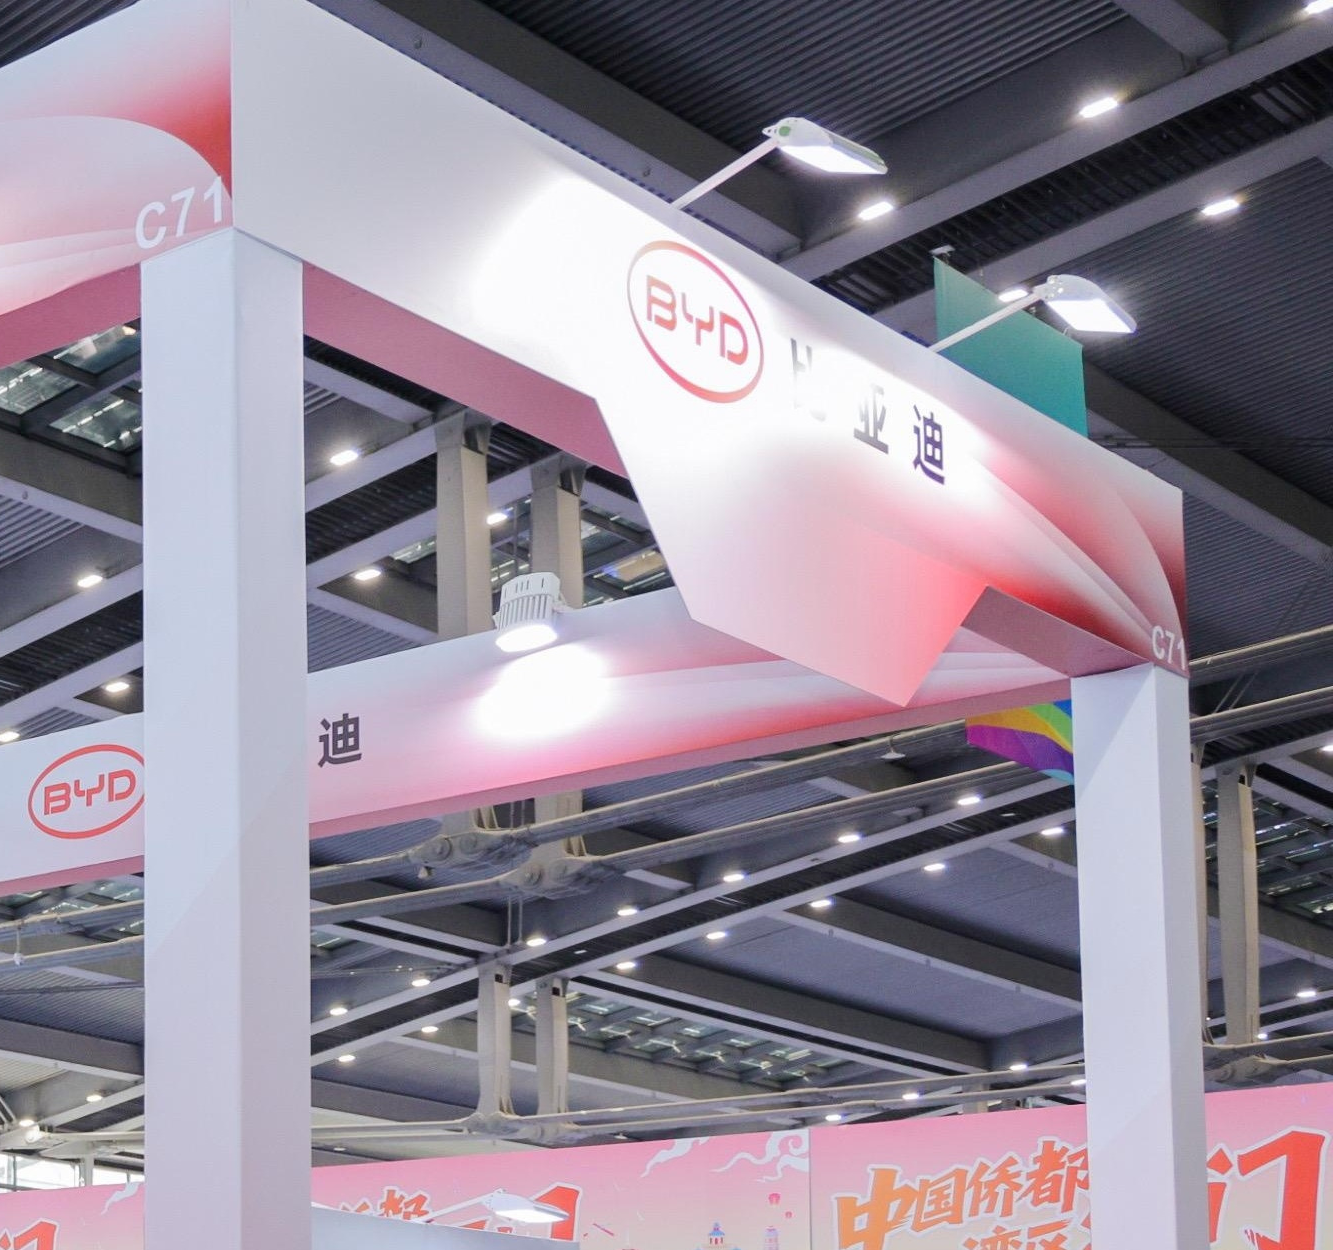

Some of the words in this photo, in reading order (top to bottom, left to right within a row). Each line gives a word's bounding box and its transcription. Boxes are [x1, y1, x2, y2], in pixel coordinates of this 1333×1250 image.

[136, 176, 223, 249] C71
[645, 275, 749, 367] BYD
[1152, 625, 1187, 671] C71
[44, 768, 136, 816] BYD
